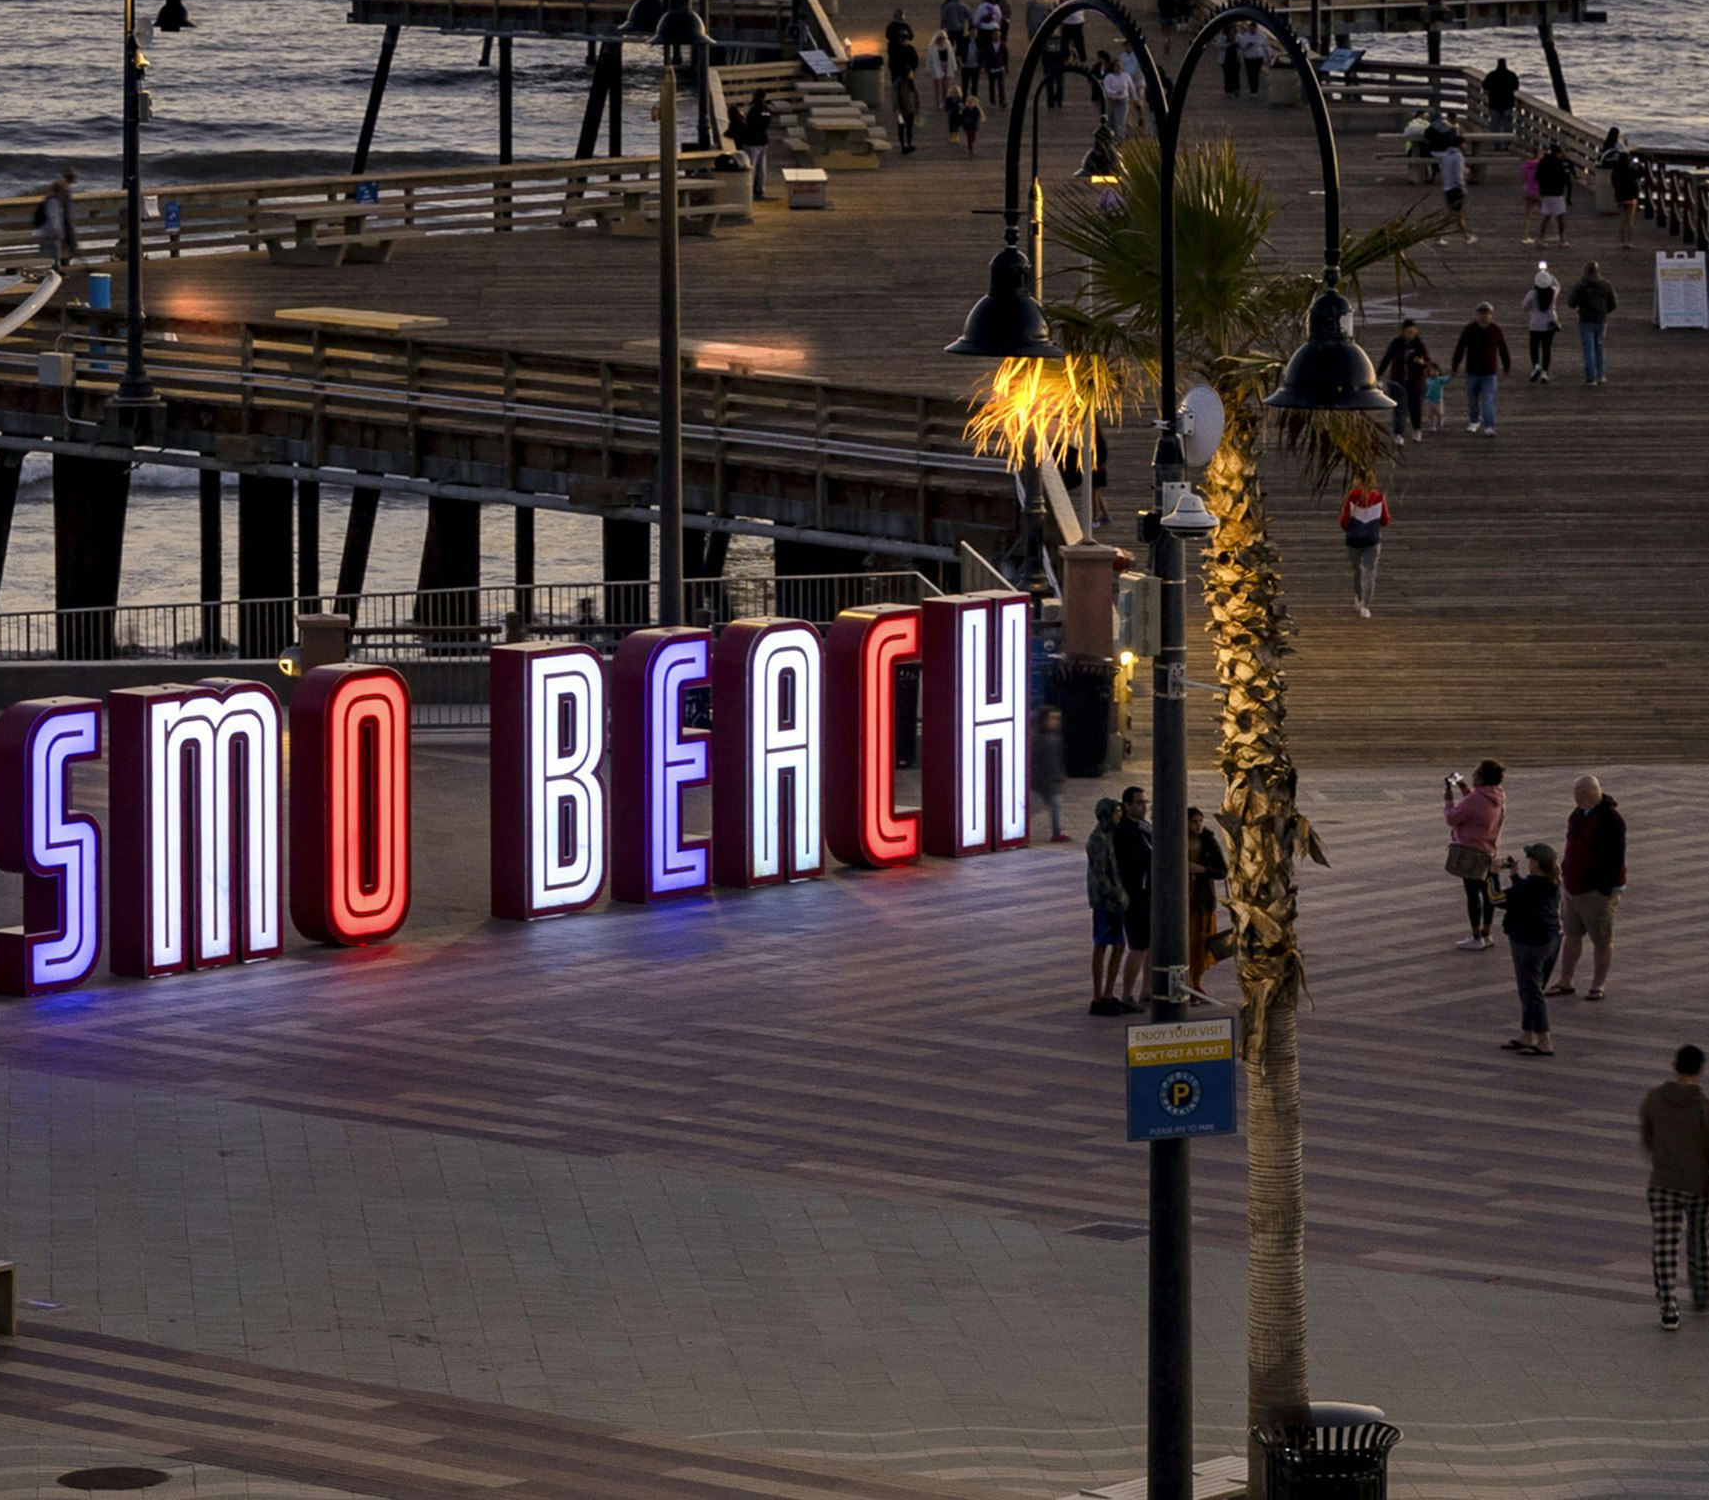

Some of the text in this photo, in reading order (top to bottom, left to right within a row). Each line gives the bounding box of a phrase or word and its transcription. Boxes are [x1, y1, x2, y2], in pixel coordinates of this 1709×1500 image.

[493, 592, 1030, 920] BEACH
[1136, 1025, 1224, 1041] ENJOY YOUR VISIT
[1135, 1045, 1224, 1061] DON'T GET A TICKET
[1161, 1070, 1199, 1088] PUBLIC
[1172, 1083, 1190, 1107] P
[1161, 1095, 1199, 1116] PARKING
[1149, 1126, 1172, 1135] PLEASE
[1188, 1124, 1197, 1132] TO
